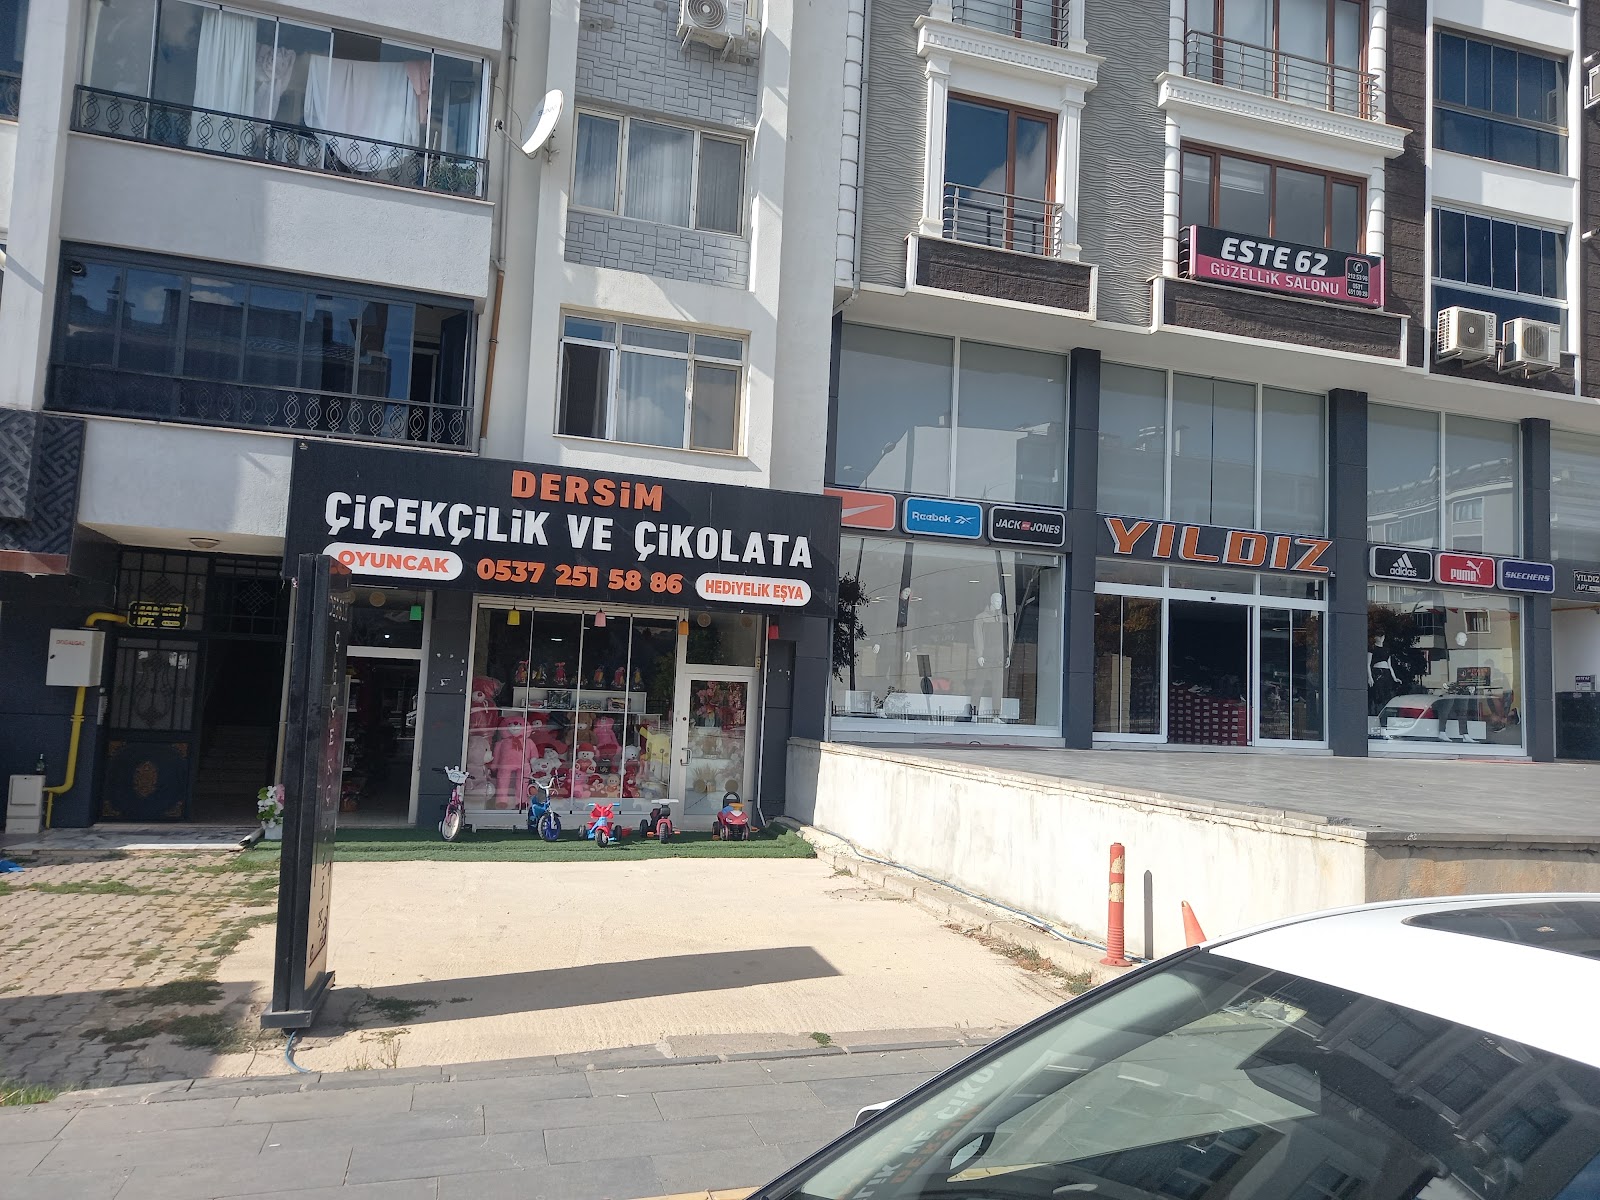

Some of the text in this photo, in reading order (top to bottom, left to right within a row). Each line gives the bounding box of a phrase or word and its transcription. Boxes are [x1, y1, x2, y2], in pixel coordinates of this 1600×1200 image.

[1220, 237, 1329, 276] ESTE 62
[1285, 274, 1339, 296] SALONU
[911, 511, 952, 523] Reebok
[995, 518, 1021, 530] JACK
[1030, 522, 1061, 534] JONES
[566, 513, 614, 551] VE
[1103, 517, 1334, 573] YILDIZ
[337, 550, 450, 574] OYUNCAK
[476, 558, 684, 594] 0537 251 58 86
[1389, 566, 1417, 578] adidas
[1450, 568, 1477, 582] PUMA
[1504, 571, 1551, 582] SKECHERS
[1575, 574, 1600, 584] YILDIZ
[773, 584, 804, 603] EŞYA
